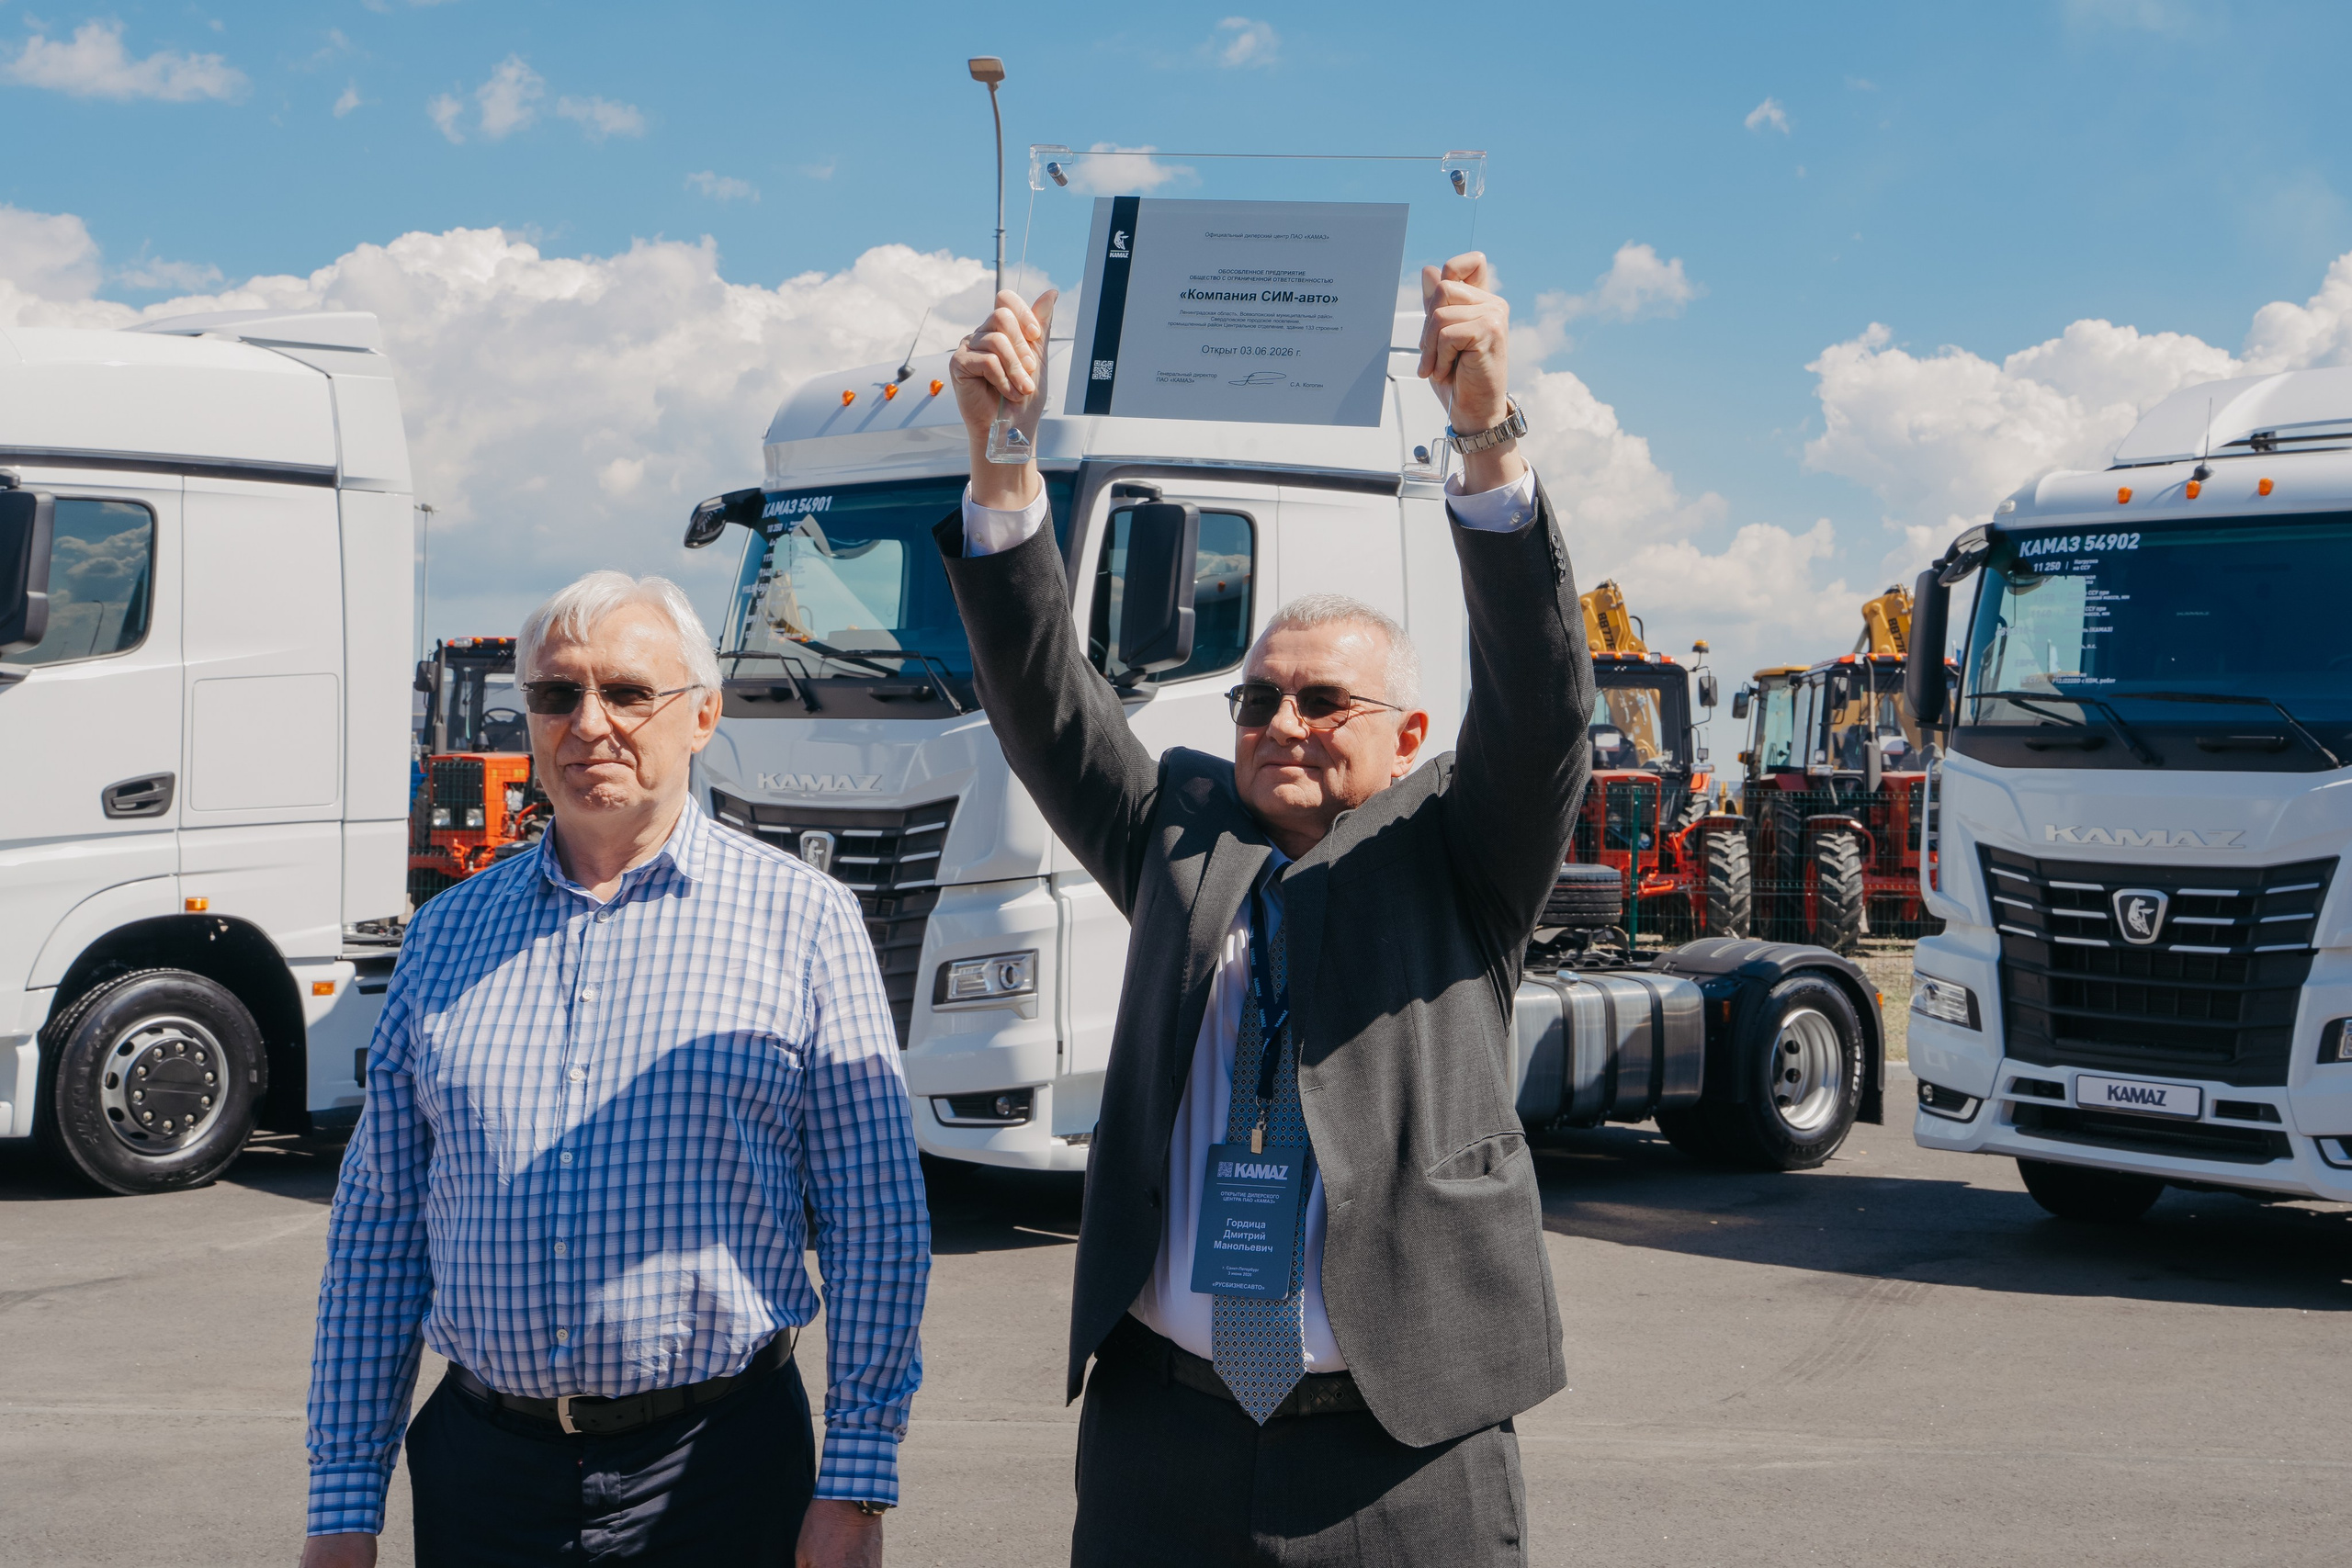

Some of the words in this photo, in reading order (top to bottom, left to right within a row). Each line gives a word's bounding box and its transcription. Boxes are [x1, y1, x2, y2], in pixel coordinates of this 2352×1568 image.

[1180, 288, 1257, 301] «Компания
[1261, 290, 1339, 303] СИМ-авто»
[1202, 345, 1238, 356] Открыт
[1240, 345, 1294, 356] 03.06.2026
[762, 499, 797, 518] КАМАЗ
[797, 496, 832, 513] 54901
[2019, 536, 2081, 558] КАМАЗ
[2084, 533, 2141, 551] 54902
[2033, 562, 2043, 571] 11
[2044, 561, 2062, 571] 250
[1598, 612, 1615, 649] BB77F
[757, 773, 882, 792] KAMAZ
[2045, 825, 2246, 849] KAMAZ
[1253, 977, 1262, 998] KAMAZ
[1274, 1010, 1288, 1028] KAMAZ
[2108, 1085, 2166, 1106] KAMAZ
[1235, 1163, 1289, 1180] KAMAZ
[1227, 1218, 1266, 1229] Гордица
[1223, 1229, 1266, 1241] Дмитрий
[1214, 1240, 1273, 1253] Манольевич
[1213, 1281, 1265, 1291] «РУСБИЗНЕСАВТО»
